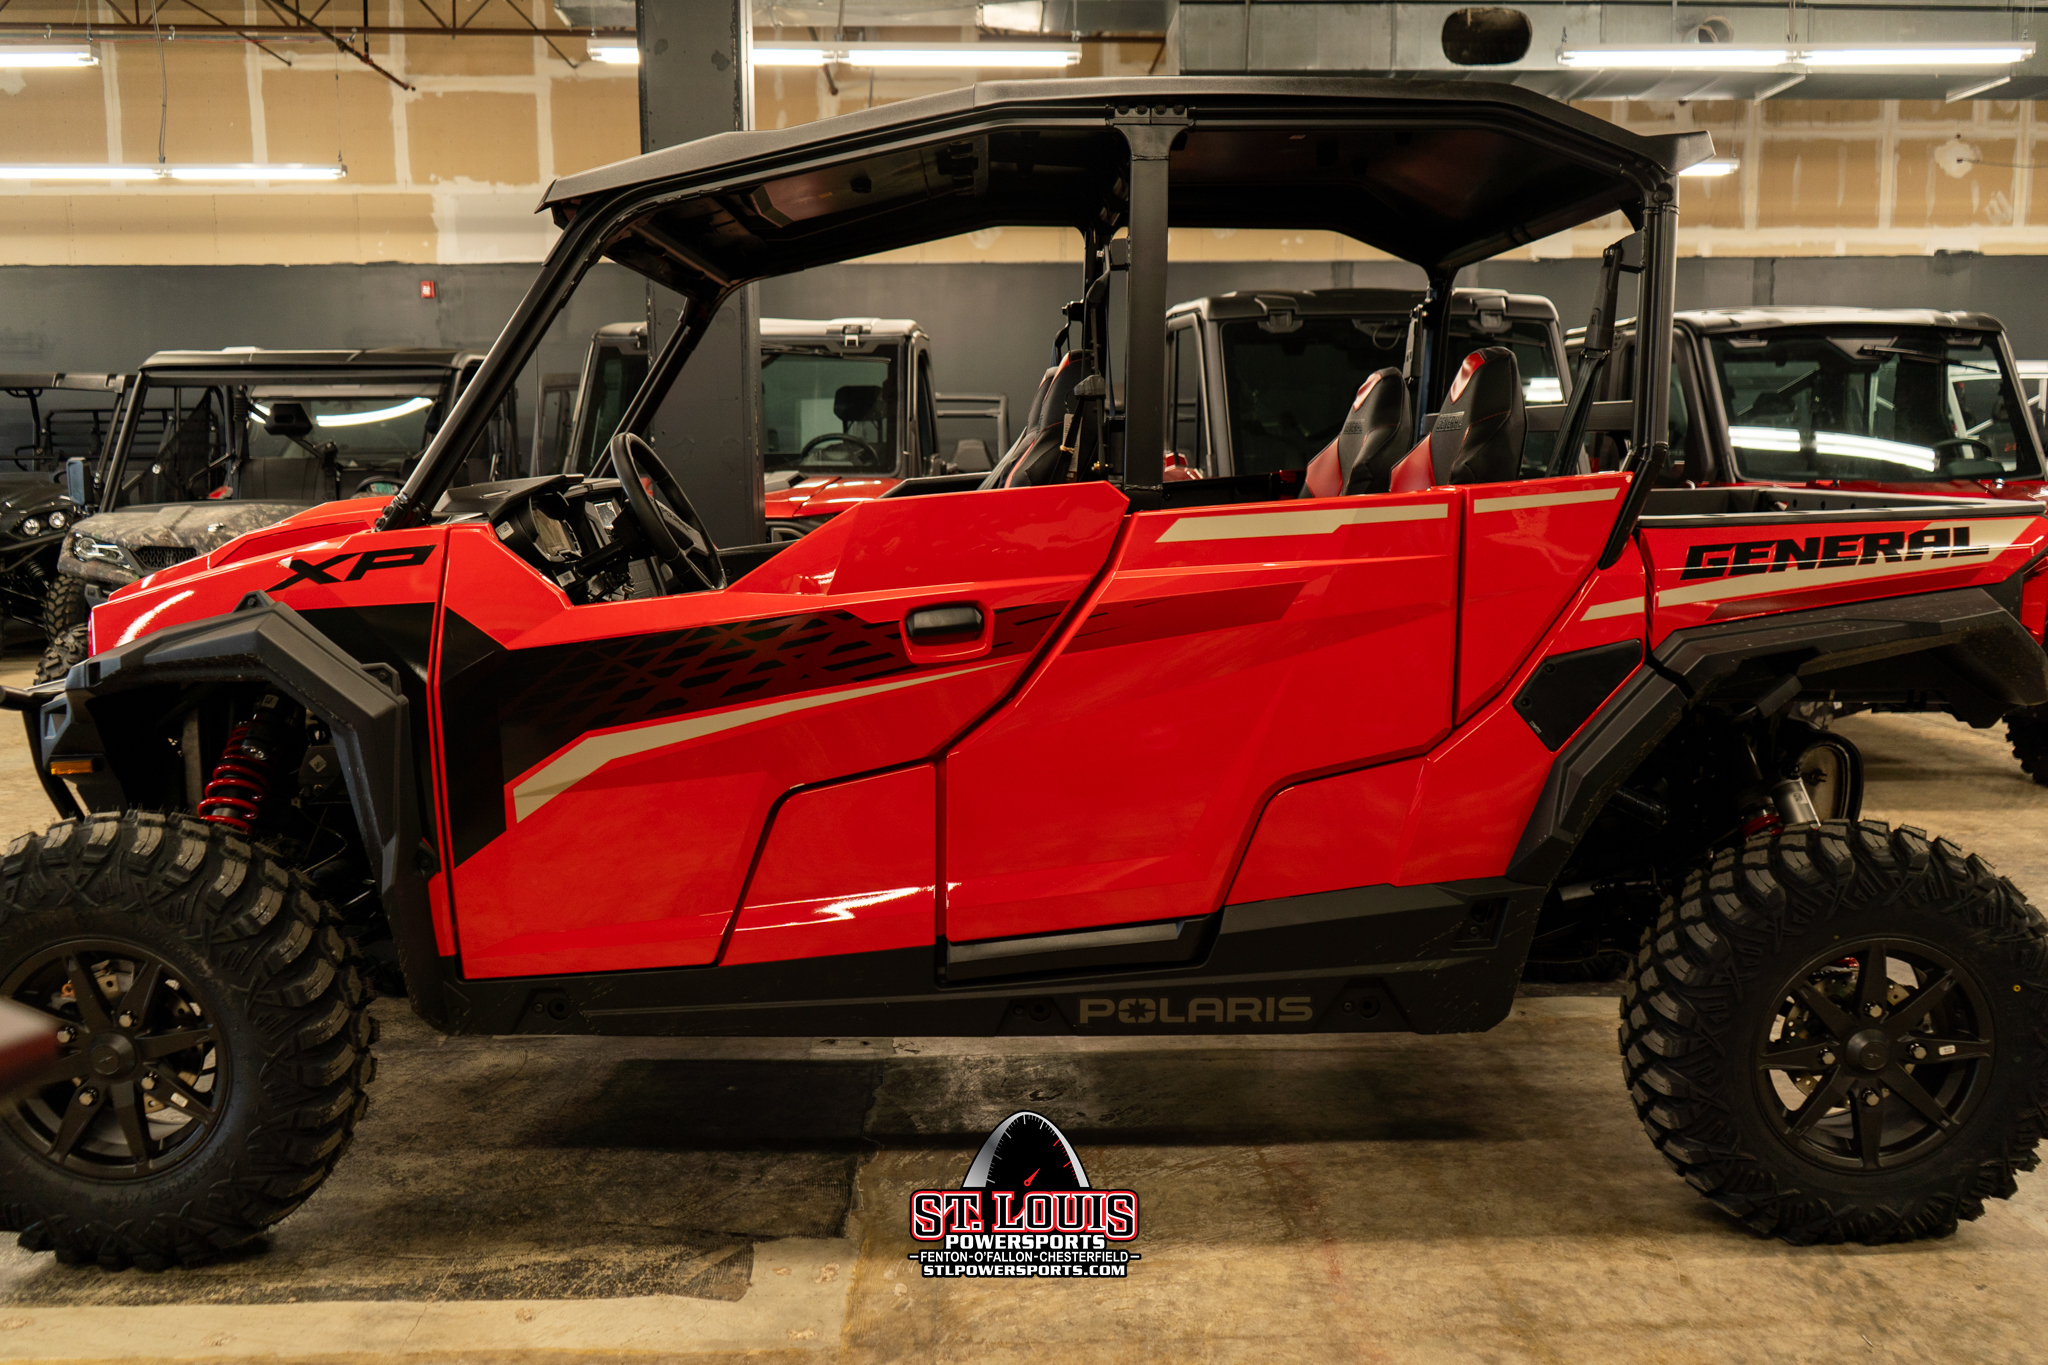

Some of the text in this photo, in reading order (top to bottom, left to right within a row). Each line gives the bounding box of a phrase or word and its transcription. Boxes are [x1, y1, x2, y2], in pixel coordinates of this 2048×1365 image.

[264, 544, 437, 592] XP
[1679, 526, 1989, 581] GENERAL
[1079, 996, 1314, 1024] POLARIS
